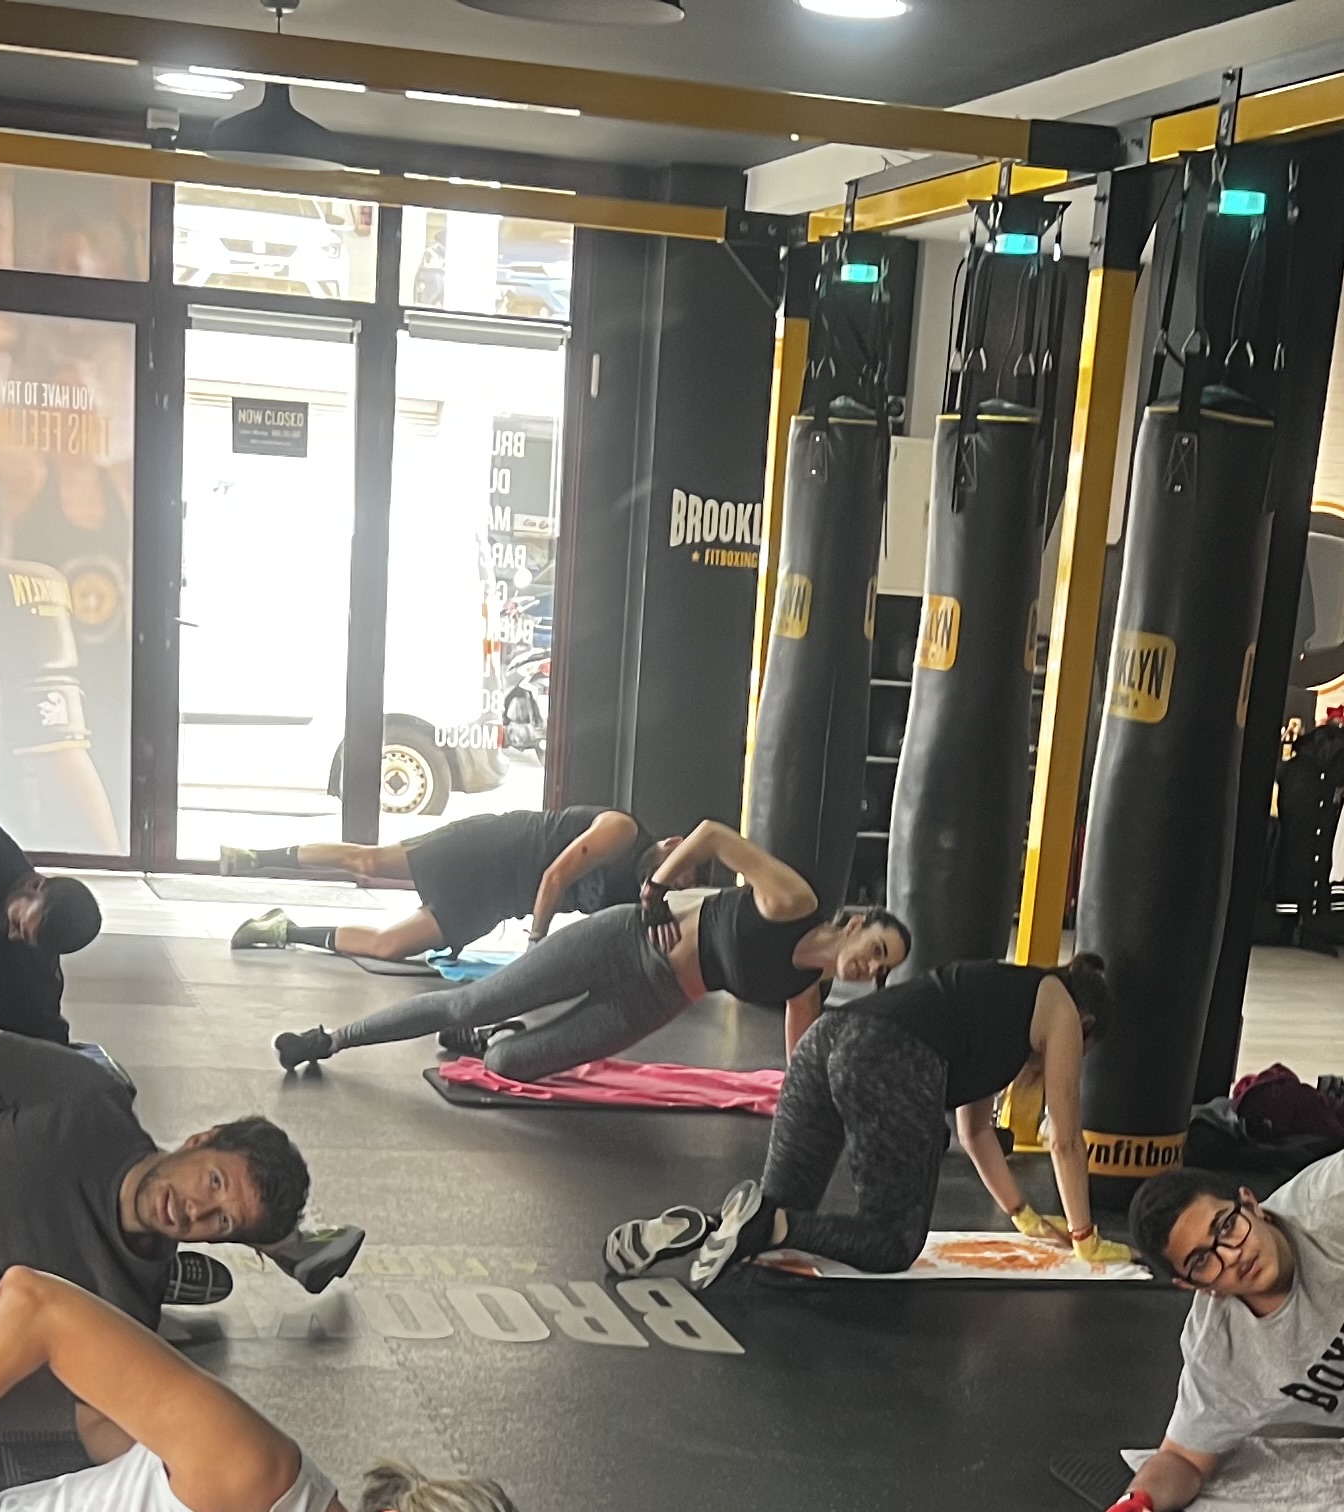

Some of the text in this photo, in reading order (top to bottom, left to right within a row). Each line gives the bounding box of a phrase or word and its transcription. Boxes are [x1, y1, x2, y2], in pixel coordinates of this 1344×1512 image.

[238, 408, 305, 428] NOW CLOSED
[669, 488, 762, 547] BROOKL
[704, 548, 758, 569] FITBOXING
[1116, 646, 1168, 700] KLYN
[1088, 1139, 1183, 1168] ynfitbox
[357, 1277, 746, 1354] BROO
